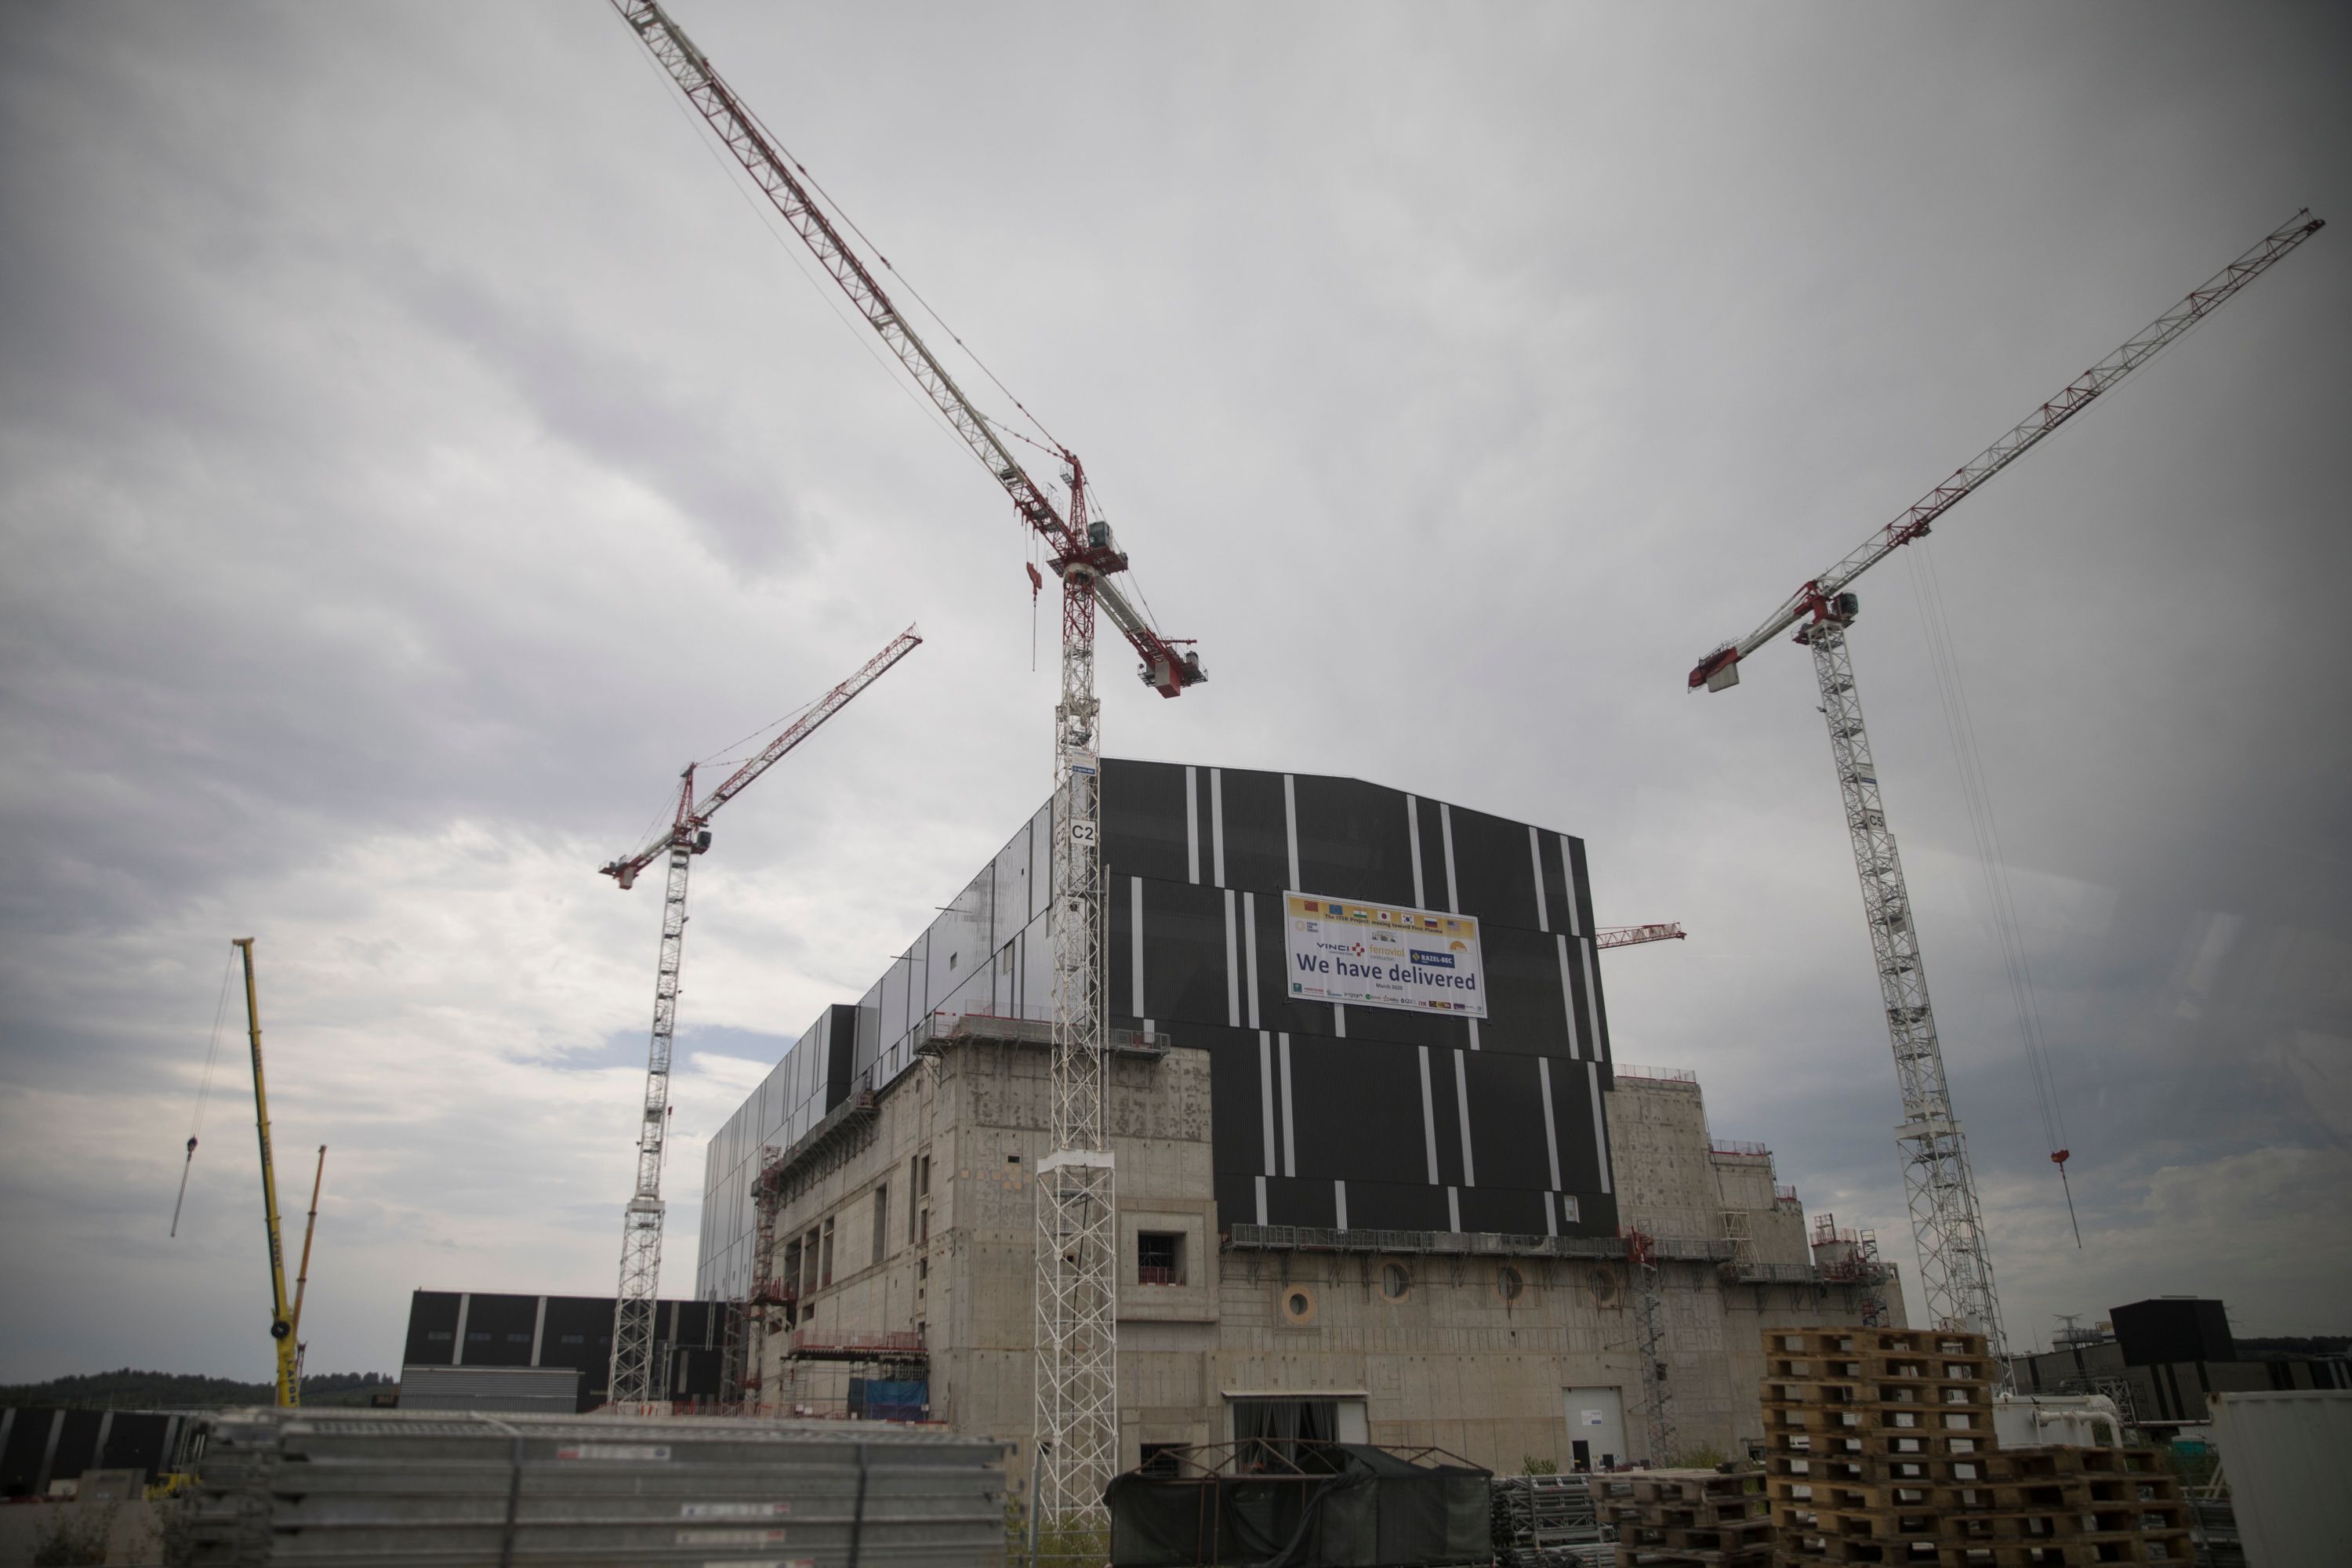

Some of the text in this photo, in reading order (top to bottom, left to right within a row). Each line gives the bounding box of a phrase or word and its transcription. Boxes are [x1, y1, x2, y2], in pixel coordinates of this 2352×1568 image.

[1869, 815, 1883, 827] C5
[1055, 827, 1065, 846] C2
[1072, 825, 1094, 840] C2
[1371, 920, 1391, 928] moving
[1317, 942, 1349, 952] VINCI
[1370, 944, 1406, 957] ferrovial
[1421, 954, 1453, 964] RAZEL-BEC
[1296, 953, 1475, 990] We have delivered
[287, 1360, 297, 1403] LAFON
